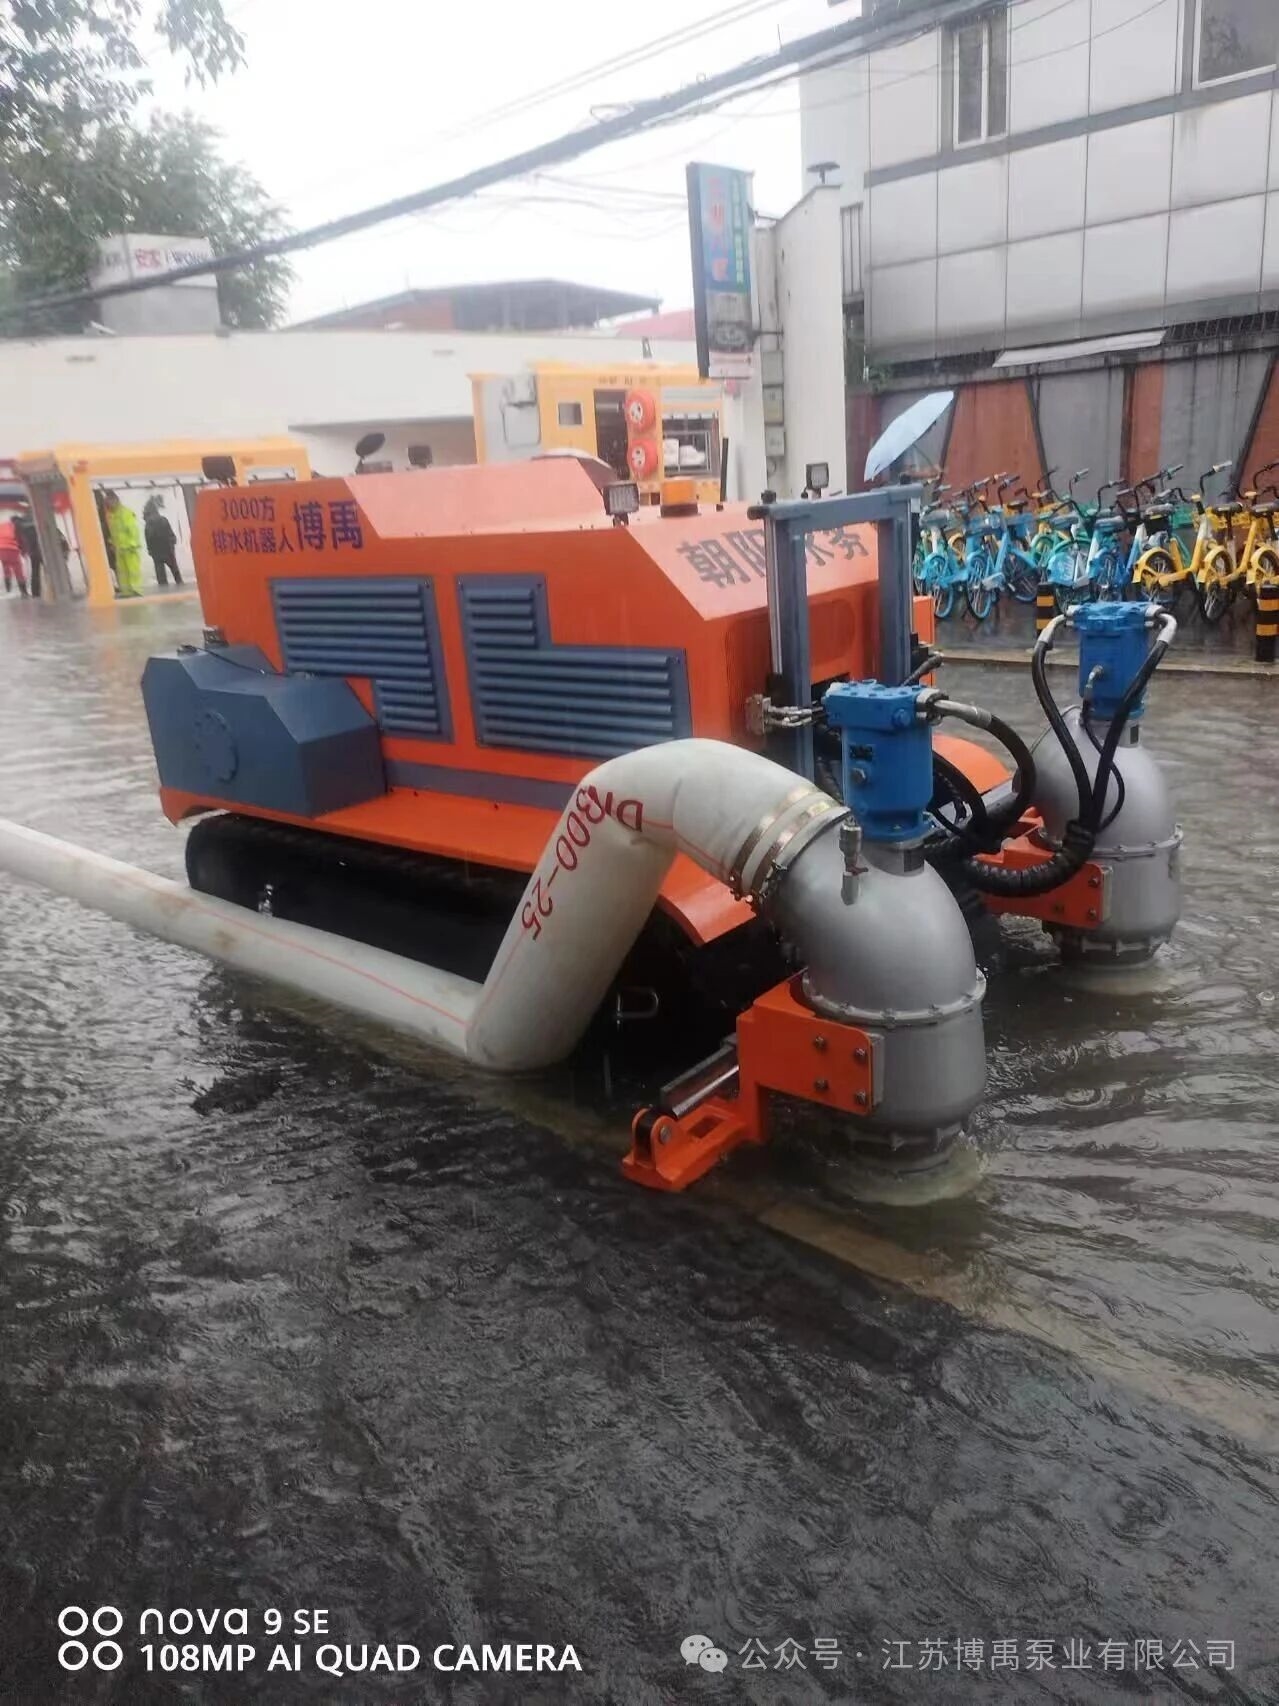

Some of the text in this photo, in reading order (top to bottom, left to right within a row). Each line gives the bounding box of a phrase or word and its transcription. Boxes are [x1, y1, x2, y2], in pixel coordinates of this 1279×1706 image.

[222, 495, 276, 523] 3000方
[211, 524, 294, 556] 排水机器人
[293, 499, 364, 552] 博禹
